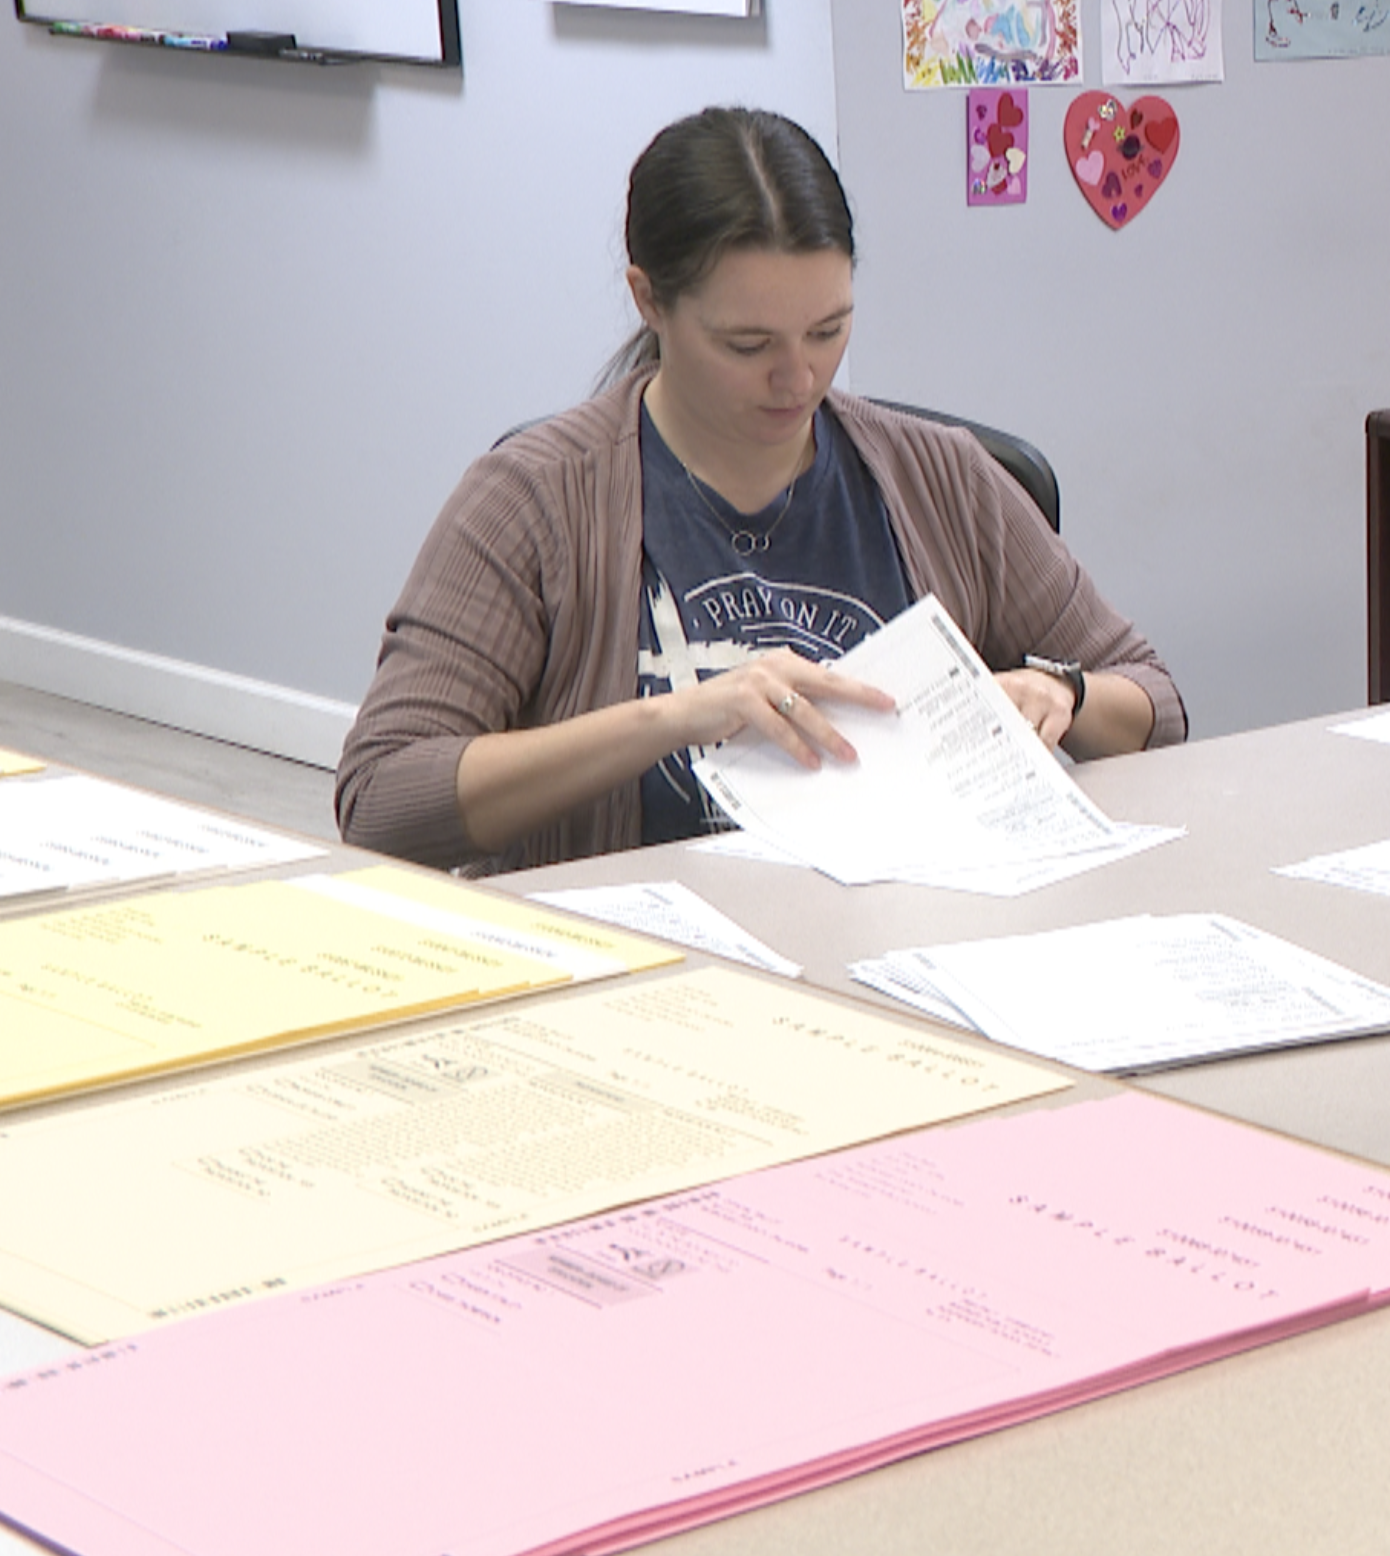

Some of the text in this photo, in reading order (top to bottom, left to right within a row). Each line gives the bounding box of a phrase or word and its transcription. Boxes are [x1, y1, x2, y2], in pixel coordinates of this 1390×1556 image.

[702, 587, 858, 645] PRAY ON IT
[772, 1016, 880, 1054] SAMPLE
[886, 1052, 1000, 1093] BALLOT
[1007, 1194, 1280, 1300] SAMPLE BALLOT
